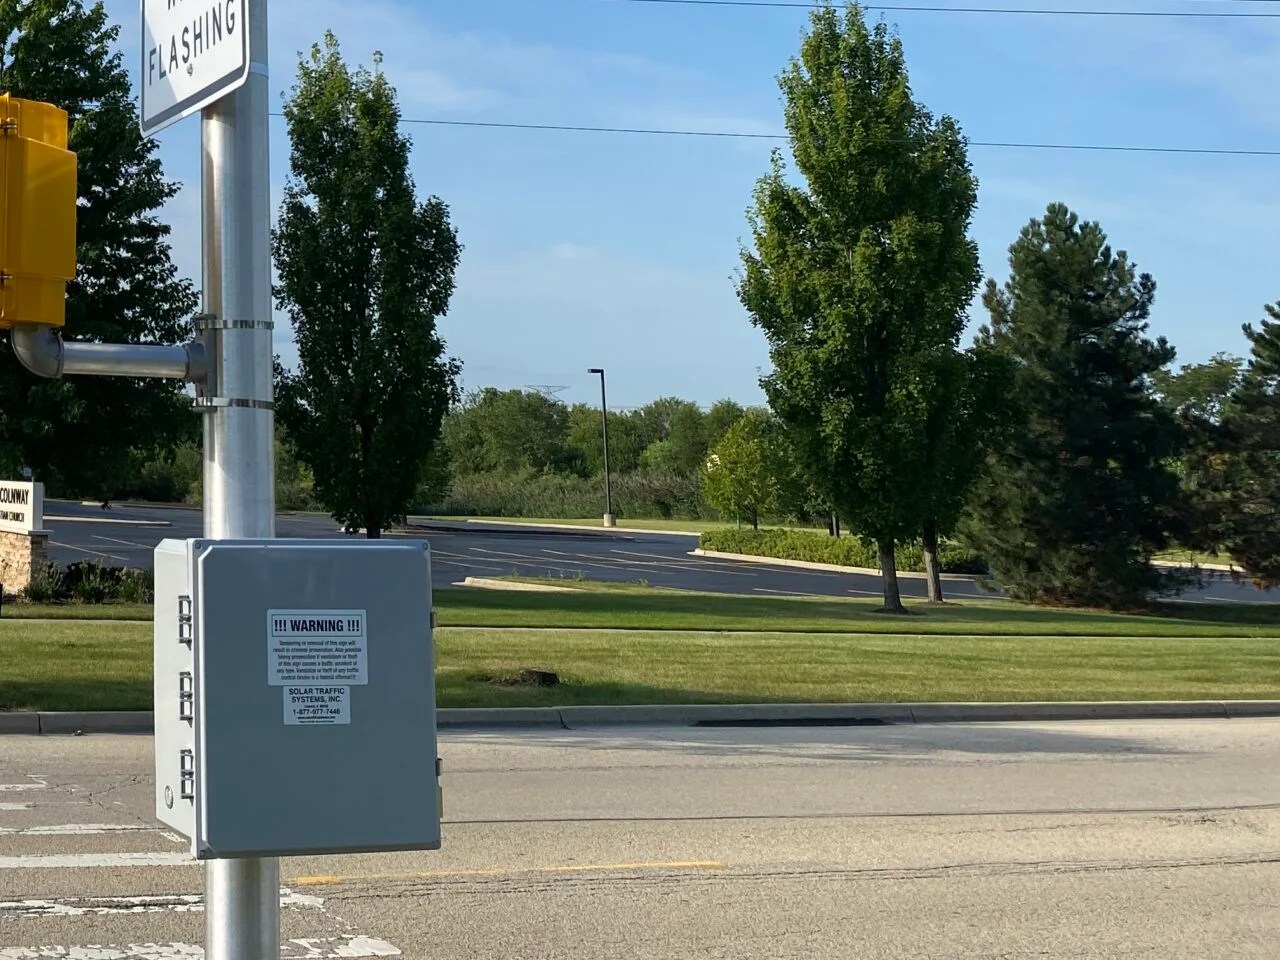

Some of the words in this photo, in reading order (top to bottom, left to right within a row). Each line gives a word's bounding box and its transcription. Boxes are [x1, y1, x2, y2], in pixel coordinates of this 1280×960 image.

[9, 511, 25, 522] CHURCH
[274, 619, 287, 632] !!!
[290, 619, 344, 632] WARNING
[347, 619, 360, 632] !!!
[289, 687, 314, 696] SOLAR
[315, 687, 345, 696] TRAFFIC
[291, 695, 327, 704] SYSTEMS,
[328, 695, 343, 704] INC.
